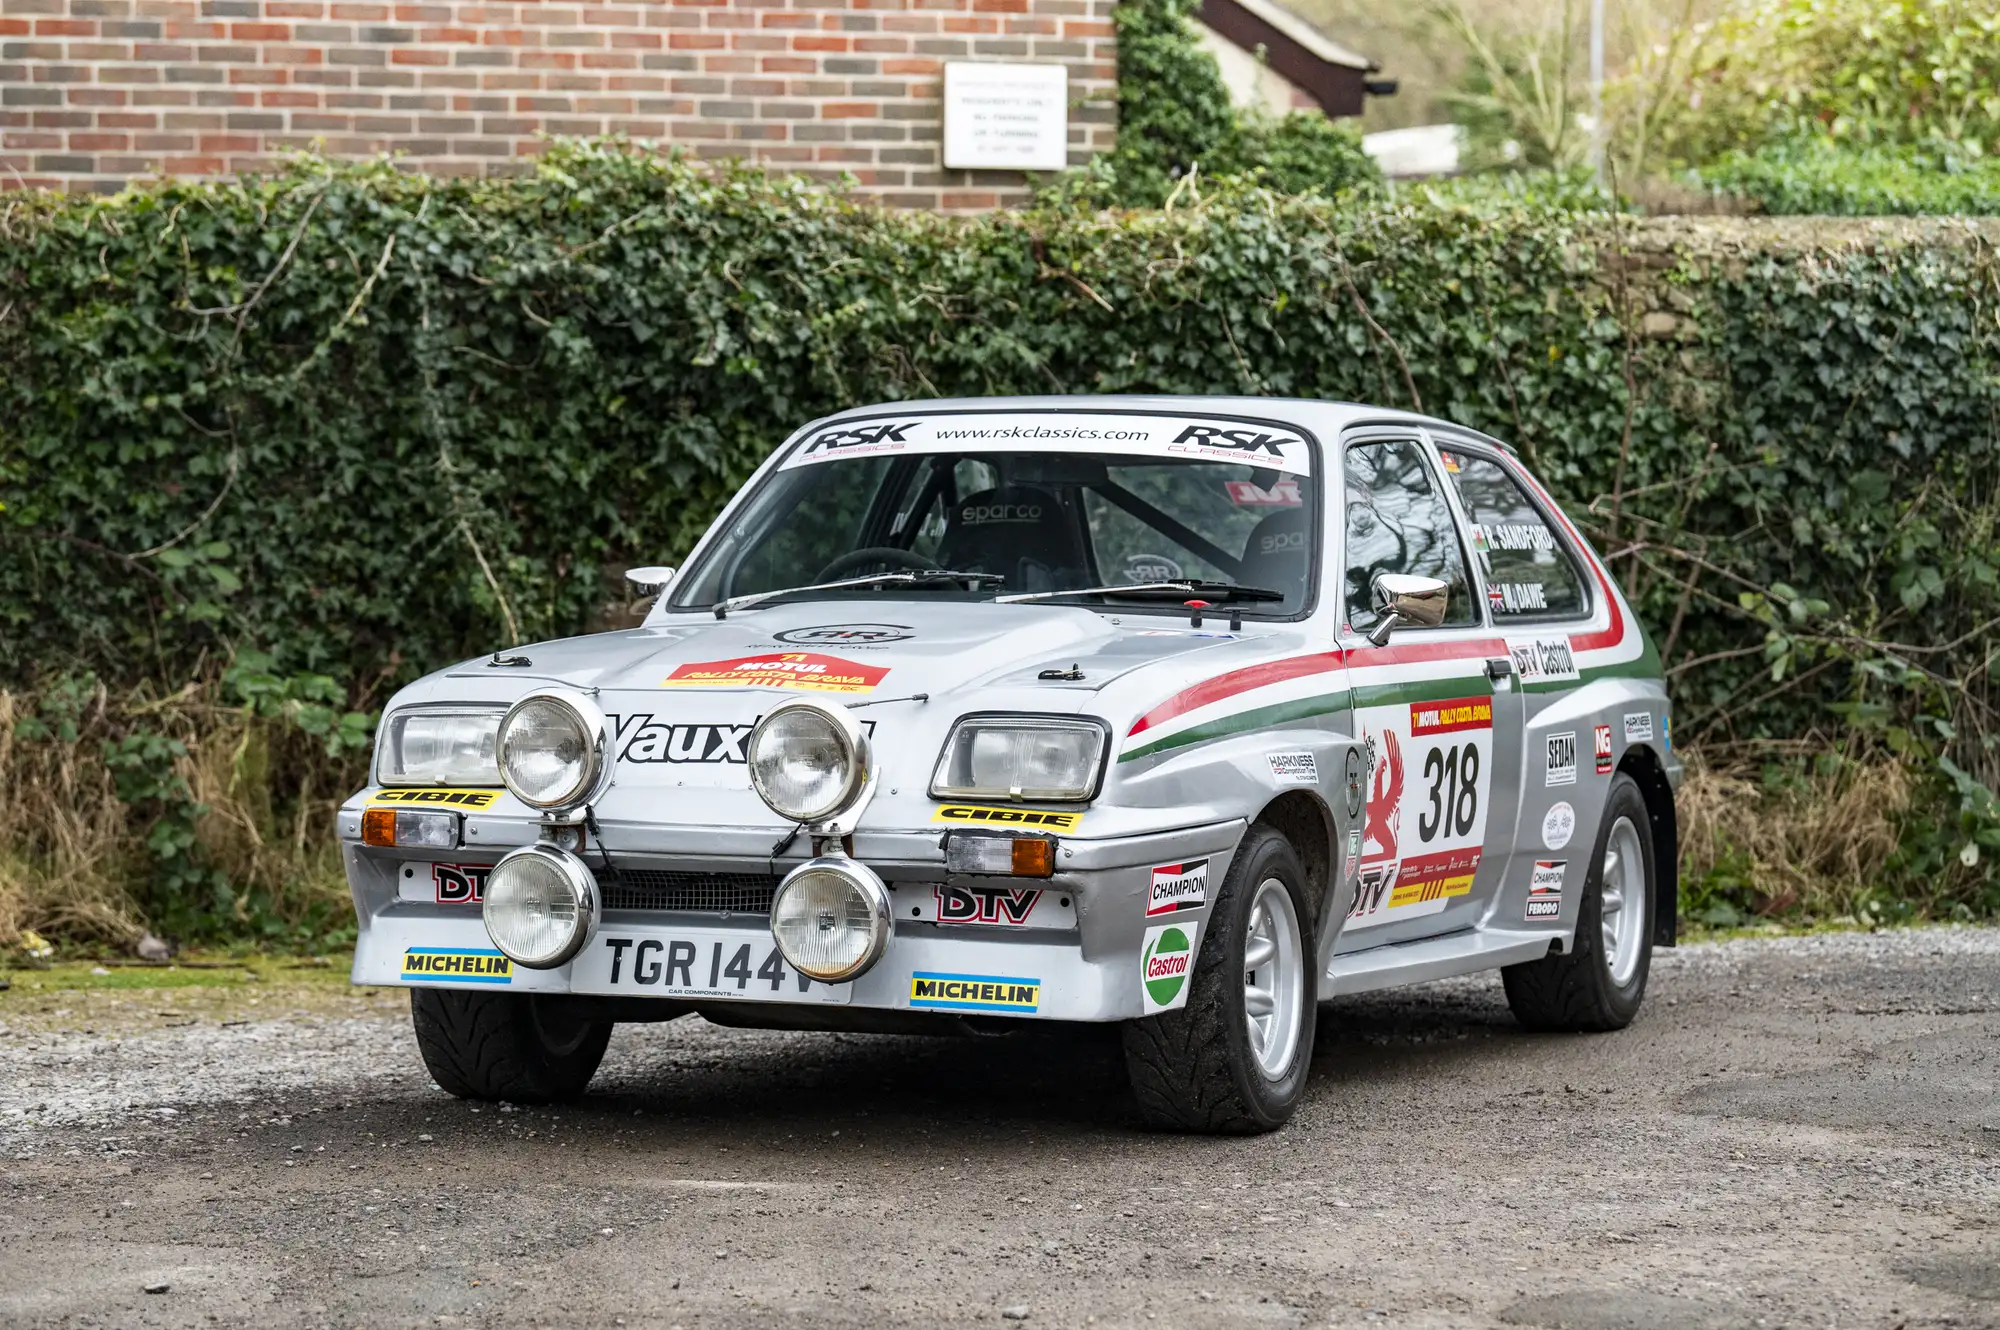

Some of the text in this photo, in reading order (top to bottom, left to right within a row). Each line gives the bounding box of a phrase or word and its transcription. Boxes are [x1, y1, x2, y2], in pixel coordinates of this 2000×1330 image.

[803, 422, 923, 454] RSK
[936, 426, 1150, 441] www.rskclassics.com
[1171, 425, 1300, 457] RSK
[1167, 445, 1284, 465] CLASSICS
[962, 504, 1041, 523] sparco
[1260, 532, 1304, 554] spa
[1496, 525, 1553, 549] SANDFORD
[1514, 583, 1548, 609] DAWE
[733, 662, 828, 673] MOTUL
[780, 654, 808, 662] 71
[1536, 640, 1575, 675] Castrol
[740, 671, 796, 680] COSTA
[798, 674, 866, 684] BRAVA
[1418, 710, 1440, 727] MOTUL
[1268, 754, 1315, 768] HARKNESS
[1548, 737, 1575, 769] SEDAN
[375, 791, 494, 806] CIBIE
[1418, 742, 1480, 843] 318
[941, 807, 1074, 828] CIBIE
[432, 863, 495, 904] DT
[1152, 876, 1206, 900] CHAMPION
[1534, 871, 1563, 885] CHAMPION
[934, 886, 1044, 924] DTV
[1528, 902, 1558, 915] FERODO
[405, 955, 509, 974] MICHELIN
[606, 938, 697, 987] TGR
[1148, 953, 1189, 978] Castrol
[684, 989, 732, 997] COMPONENTS
[915, 980, 1036, 1003] MICHELIN
